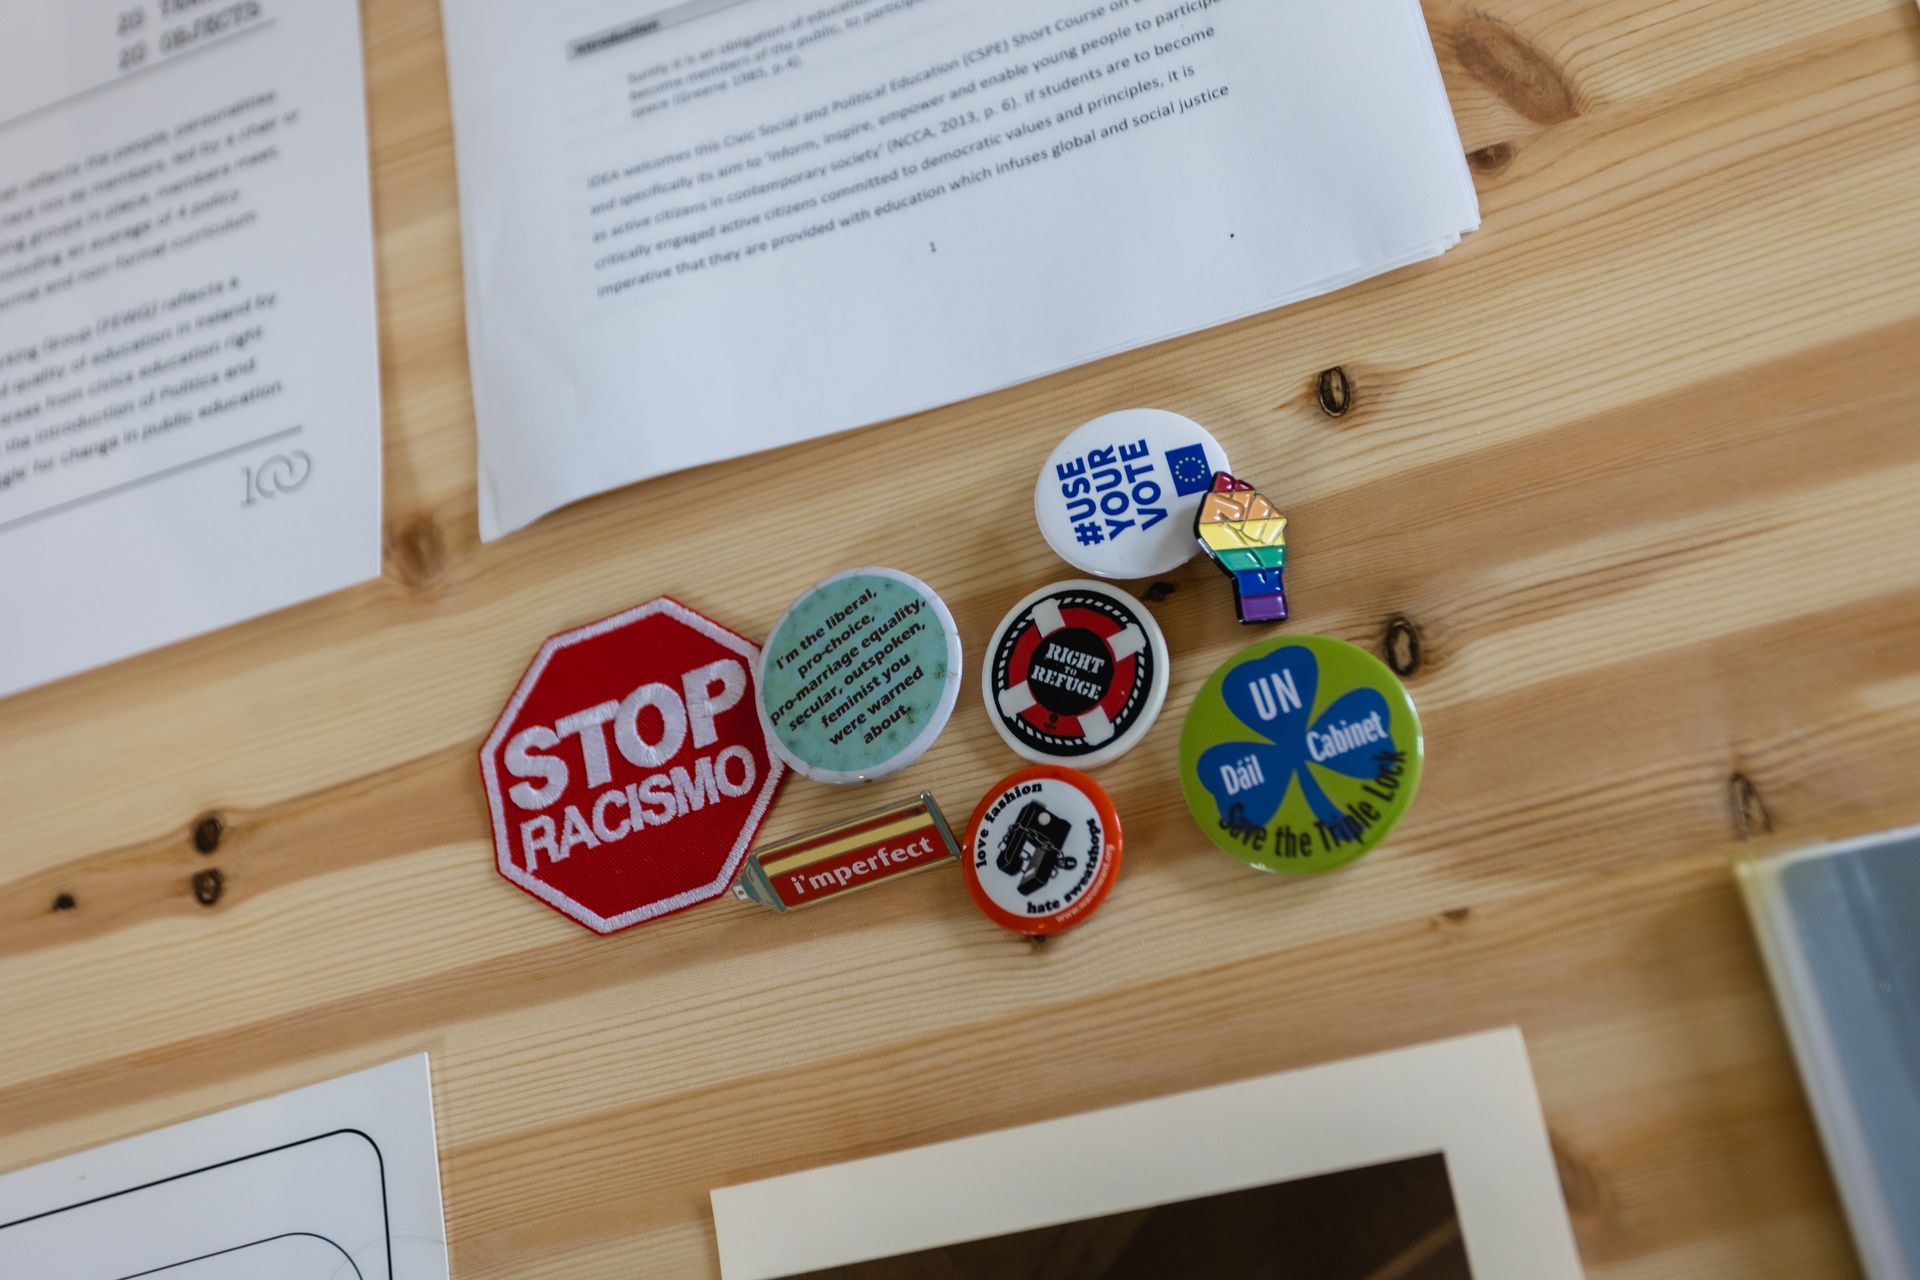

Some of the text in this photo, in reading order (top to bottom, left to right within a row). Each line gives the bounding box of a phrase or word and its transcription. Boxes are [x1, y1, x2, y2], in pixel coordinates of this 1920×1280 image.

[586, 169, 620, 189] IDEA
[622, 150, 692, 178] welcomes
[693, 141, 721, 157] this
[722, 129, 756, 148] Civic
[757, 114, 800, 137] Social
[802, 104, 830, 123] and
[830, 83, 887, 112] Political
[888, 59, 960, 93] Education
[962, 39, 1010, 67] (CSPE)
[1011, 24, 1052, 48] Short
[1054, 6, 1106, 32] Course
[590, 197, 617, 216] and
[617, 176, 693, 207] specifically
[696, 170, 715, 184] its
[716, 161, 745, 178] aim
[744, 156, 763, 169] to
[877, 93, 944, 126] empower
[948, 79, 977, 101] and
[979, 64, 1029, 89] enable
[1031, 46, 1078, 72] young
[1080, 26, 1131, 55] people
[1134, 19, 1152, 32] to
[592, 229, 608, 243] as
[610, 216, 651, 237] active
[653, 201, 708, 224] citizens
[709, 196, 725, 209] in
[726, 164, 827, 203] contemporary
[1024, 88, 1035, 103] If
[1038, 67, 1103, 99] students
[1106, 57, 1130, 74] are
[1133, 50, 1151, 63] to
[1153, 26, 1215, 56] become
[594, 243, 652, 270] critically
[654, 225, 717, 251] engaged
[719, 214, 761, 235] active
[763, 197, 818, 221] citizens
[820, 167, 899, 204] committed
[900, 164, 918, 177] to
[920, 134, 1002, 171] democratic
[1004, 116, 1053, 141] values
[1055, 102, 1084, 123] and
[1167, 70, 1179, 83] it
[1182, 65, 1195, 78] is
[596, 85, 1229, 298] imperative that they are provided with education which infuses global and social justice
[1056, 456, 1105, 546] #USE
[1087, 444, 1136, 541] YOUR
[1118, 438, 1168, 531] VOTE
[770, 598, 926, 727] pro-marriage equality,
[776, 588, 877, 670] I'm the liberal,
[797, 613, 875, 679] pro-choice,
[1045, 642, 1105, 675] RIGHT
[1064, 665, 1078, 676] TO
[788, 621, 926, 732] secular, outspoken,
[821, 653, 911, 728] feminist you
[828, 665, 924, 746] were warned
[1031, 664, 1102, 700] REFUGE
[1248, 668, 1303, 721] UN
[504, 658, 747, 810] STOP
[863, 704, 912, 744] about.
[1305, 710, 1388, 763] Cabinet
[520, 744, 756, 873] RACISMO
[1218, 751, 1406, 858] Save the Triple Lock
[1219, 754, 1265, 796] Dáil
[791, 836, 934, 895] i'mperfect
[976, 782, 1042, 869] love fashion
[1026, 818, 1101, 914] hate sweatshops
